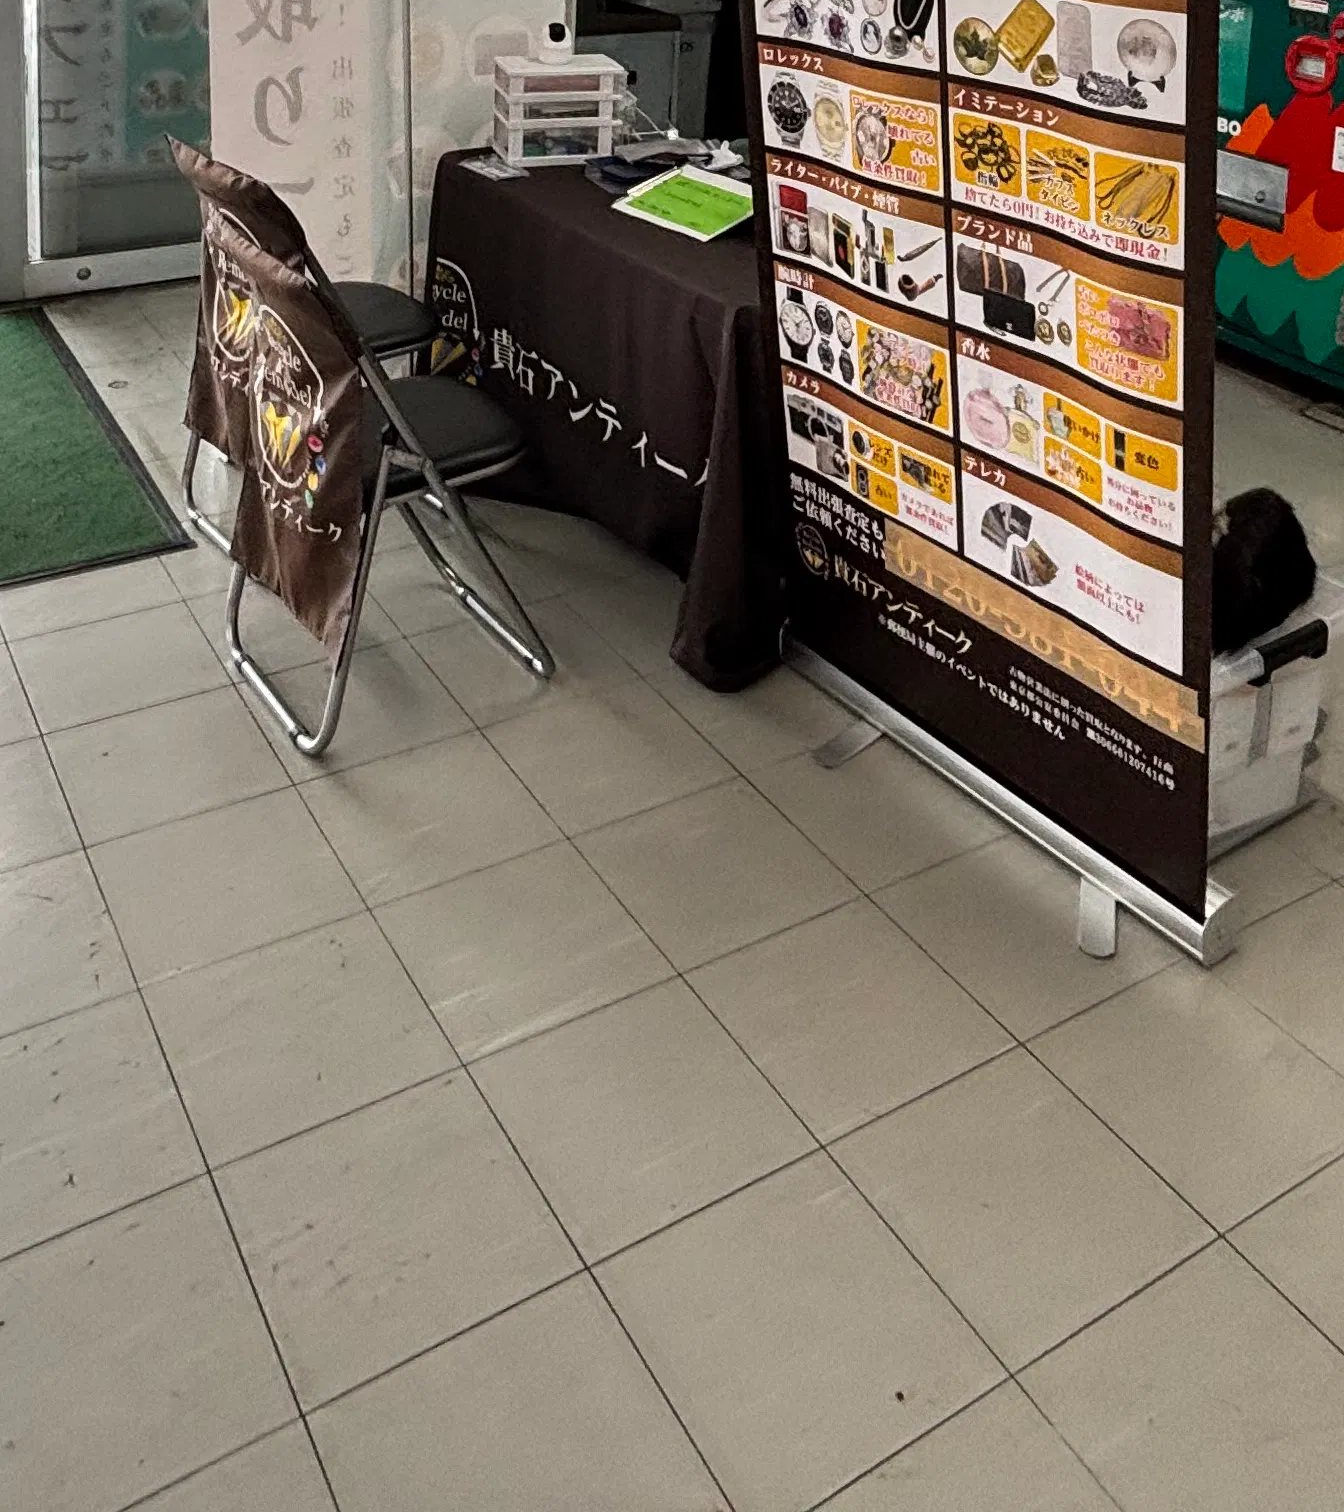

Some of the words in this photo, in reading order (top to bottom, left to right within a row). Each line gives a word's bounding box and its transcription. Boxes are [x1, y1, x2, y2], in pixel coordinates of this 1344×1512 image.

[762, 49, 825, 72] ロレックス
[953, 89, 1061, 127] イミテーション
[955, 215, 1035, 253] ブランド品
[786, 371, 821, 396] カメラ
[963, 457, 1007, 487] テレカ
